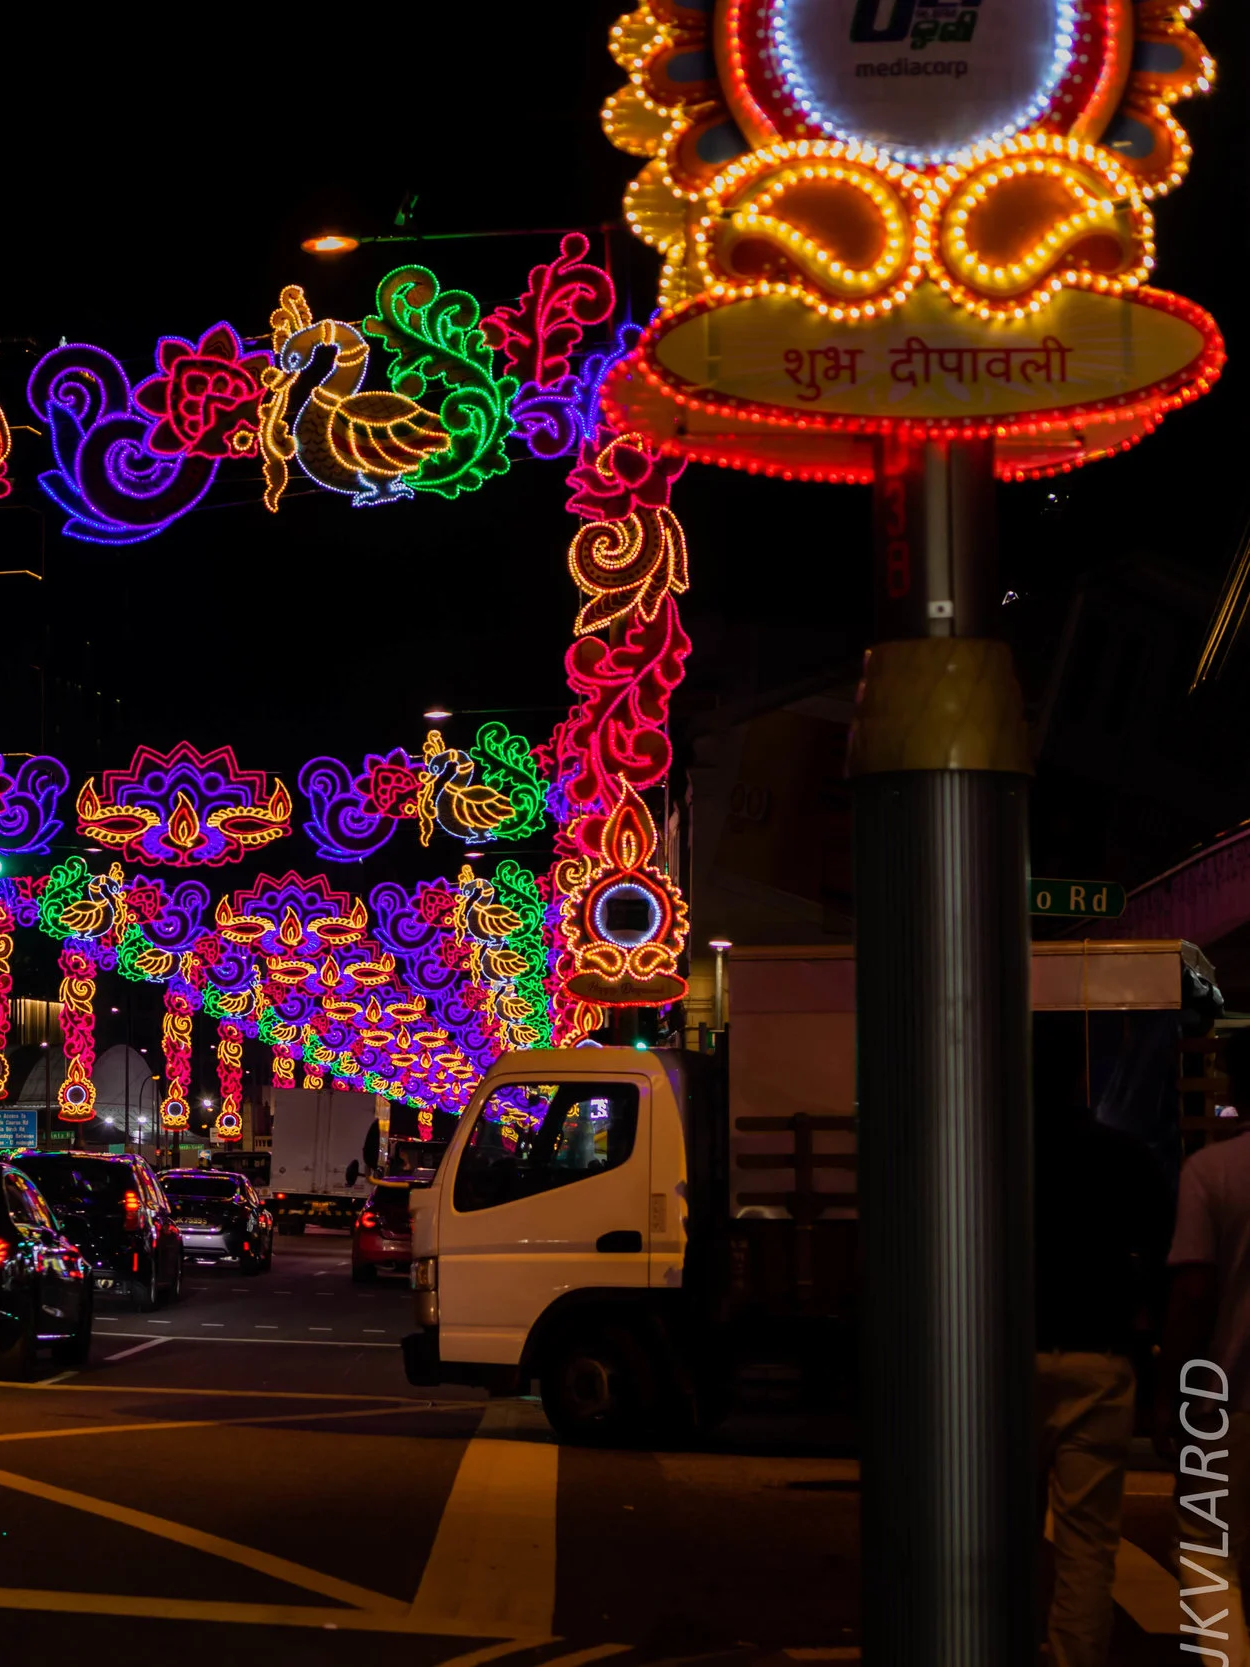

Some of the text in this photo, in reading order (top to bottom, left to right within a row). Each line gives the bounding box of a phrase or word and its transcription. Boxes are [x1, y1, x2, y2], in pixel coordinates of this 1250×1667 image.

[855, 58, 969, 79] mediacorp
[783, 336, 1073, 401] शुभ दीपावली
[1070, 885, 1107, 912] Rd
